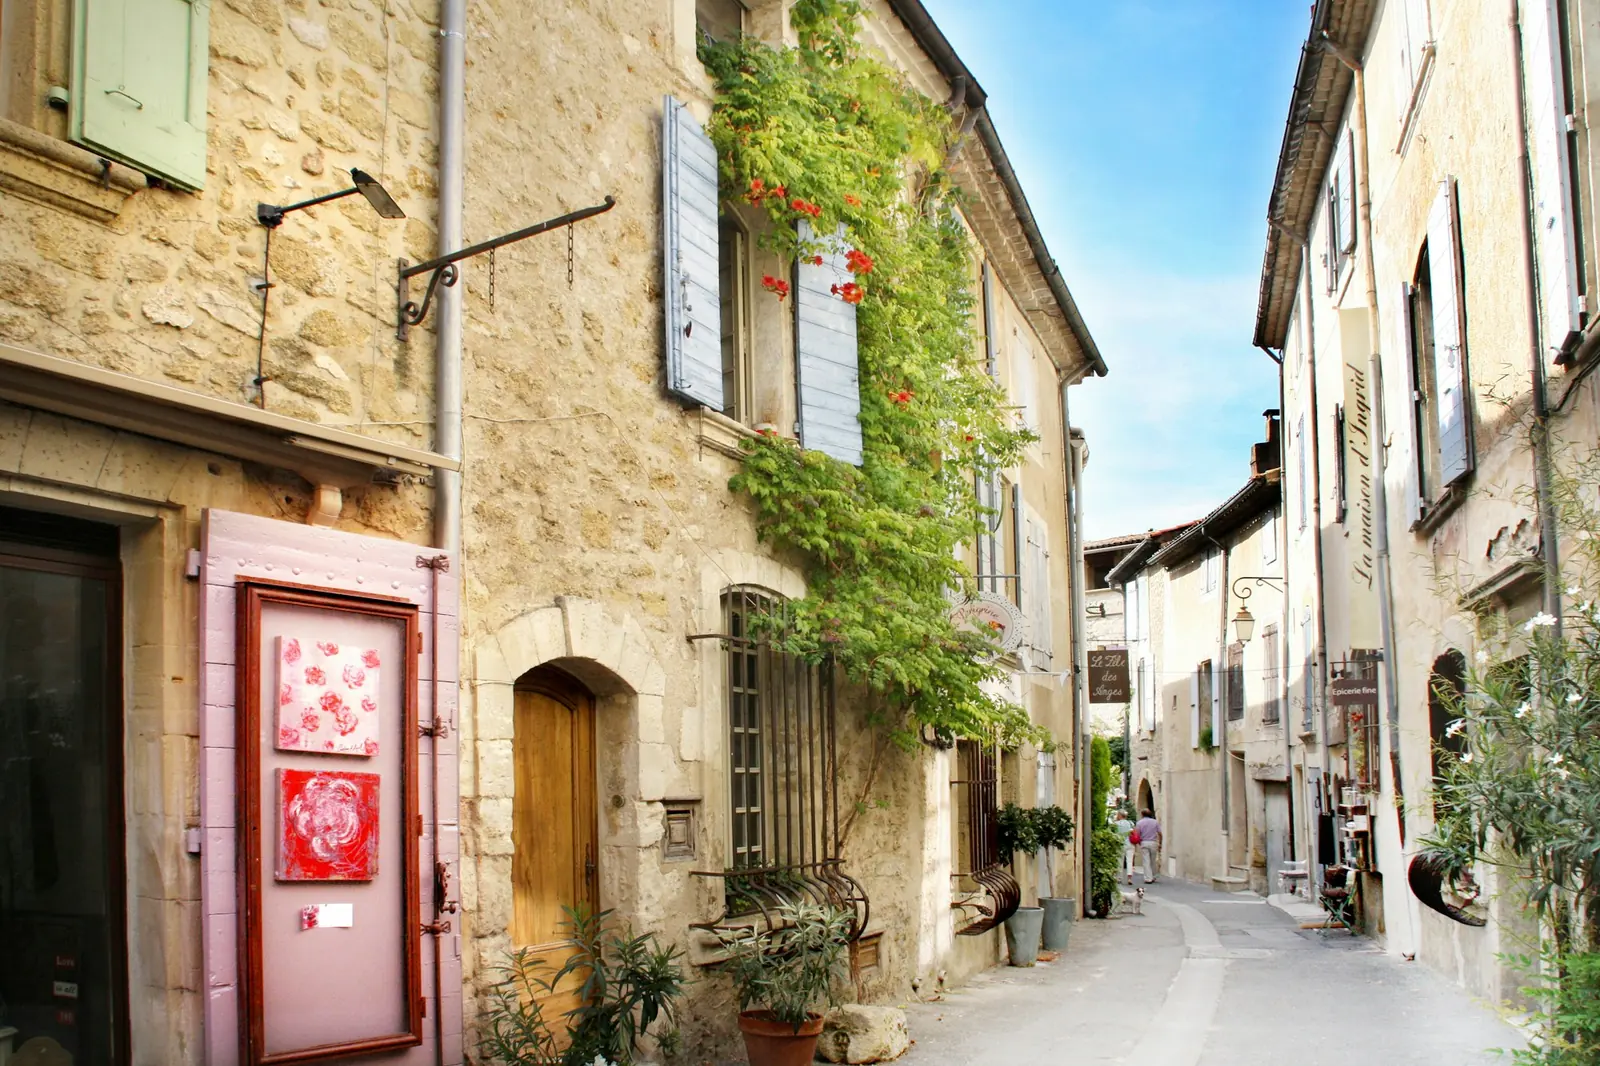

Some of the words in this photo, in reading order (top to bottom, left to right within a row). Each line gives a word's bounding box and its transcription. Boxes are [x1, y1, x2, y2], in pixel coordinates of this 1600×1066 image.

[1346, 362, 1372, 468] d'Ingrid
[1356, 474, 1373, 549] maison
[1352, 553, 1373, 592] La
[1090, 655, 1104, 668] Le
[1101, 670, 1117, 682] des
[1092, 684, 1123, 701] Anges
[1332, 687, 1361, 697] Epicerie
[1362, 686, 1377, 694] fine
